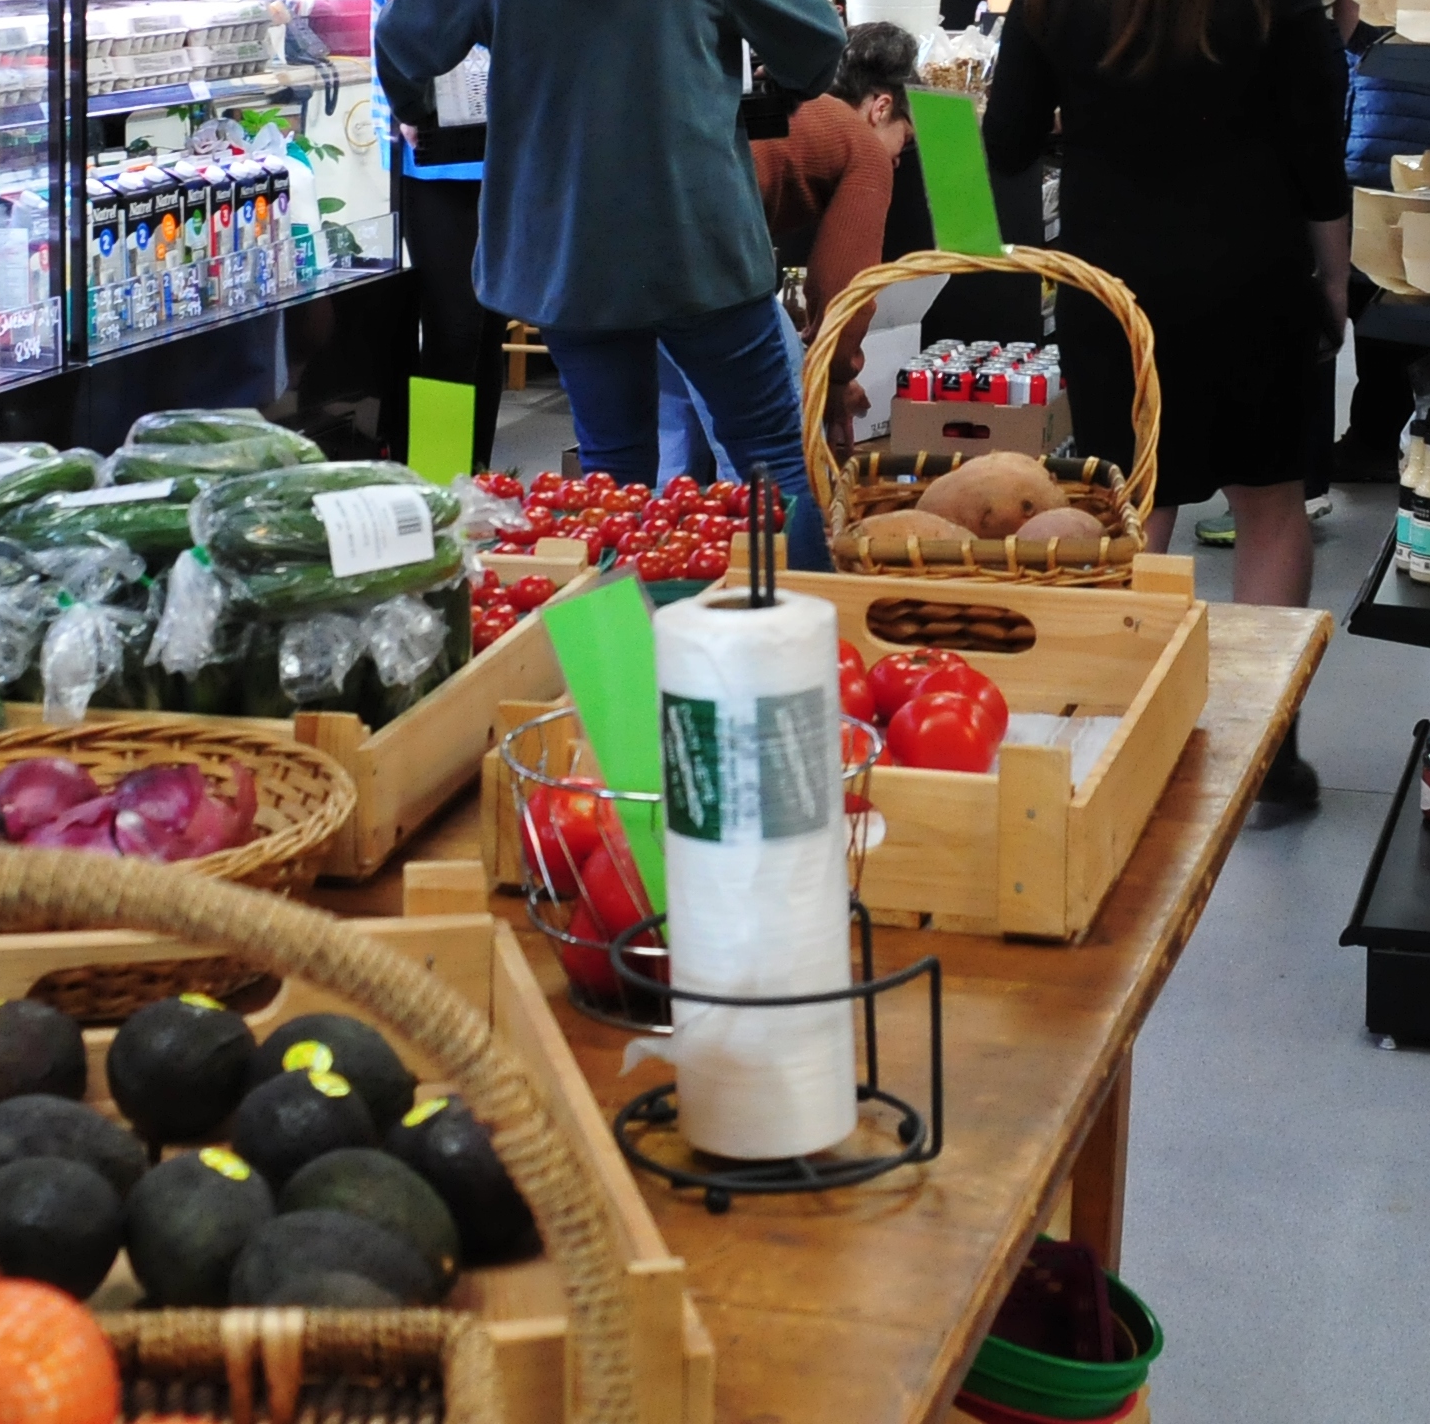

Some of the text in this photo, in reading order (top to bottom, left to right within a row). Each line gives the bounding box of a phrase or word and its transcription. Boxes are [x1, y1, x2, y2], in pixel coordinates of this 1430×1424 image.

[128, 198, 153, 218] Natrel
[155, 188, 180, 209] Natrel
[93, 203, 117, 223] Natrel
